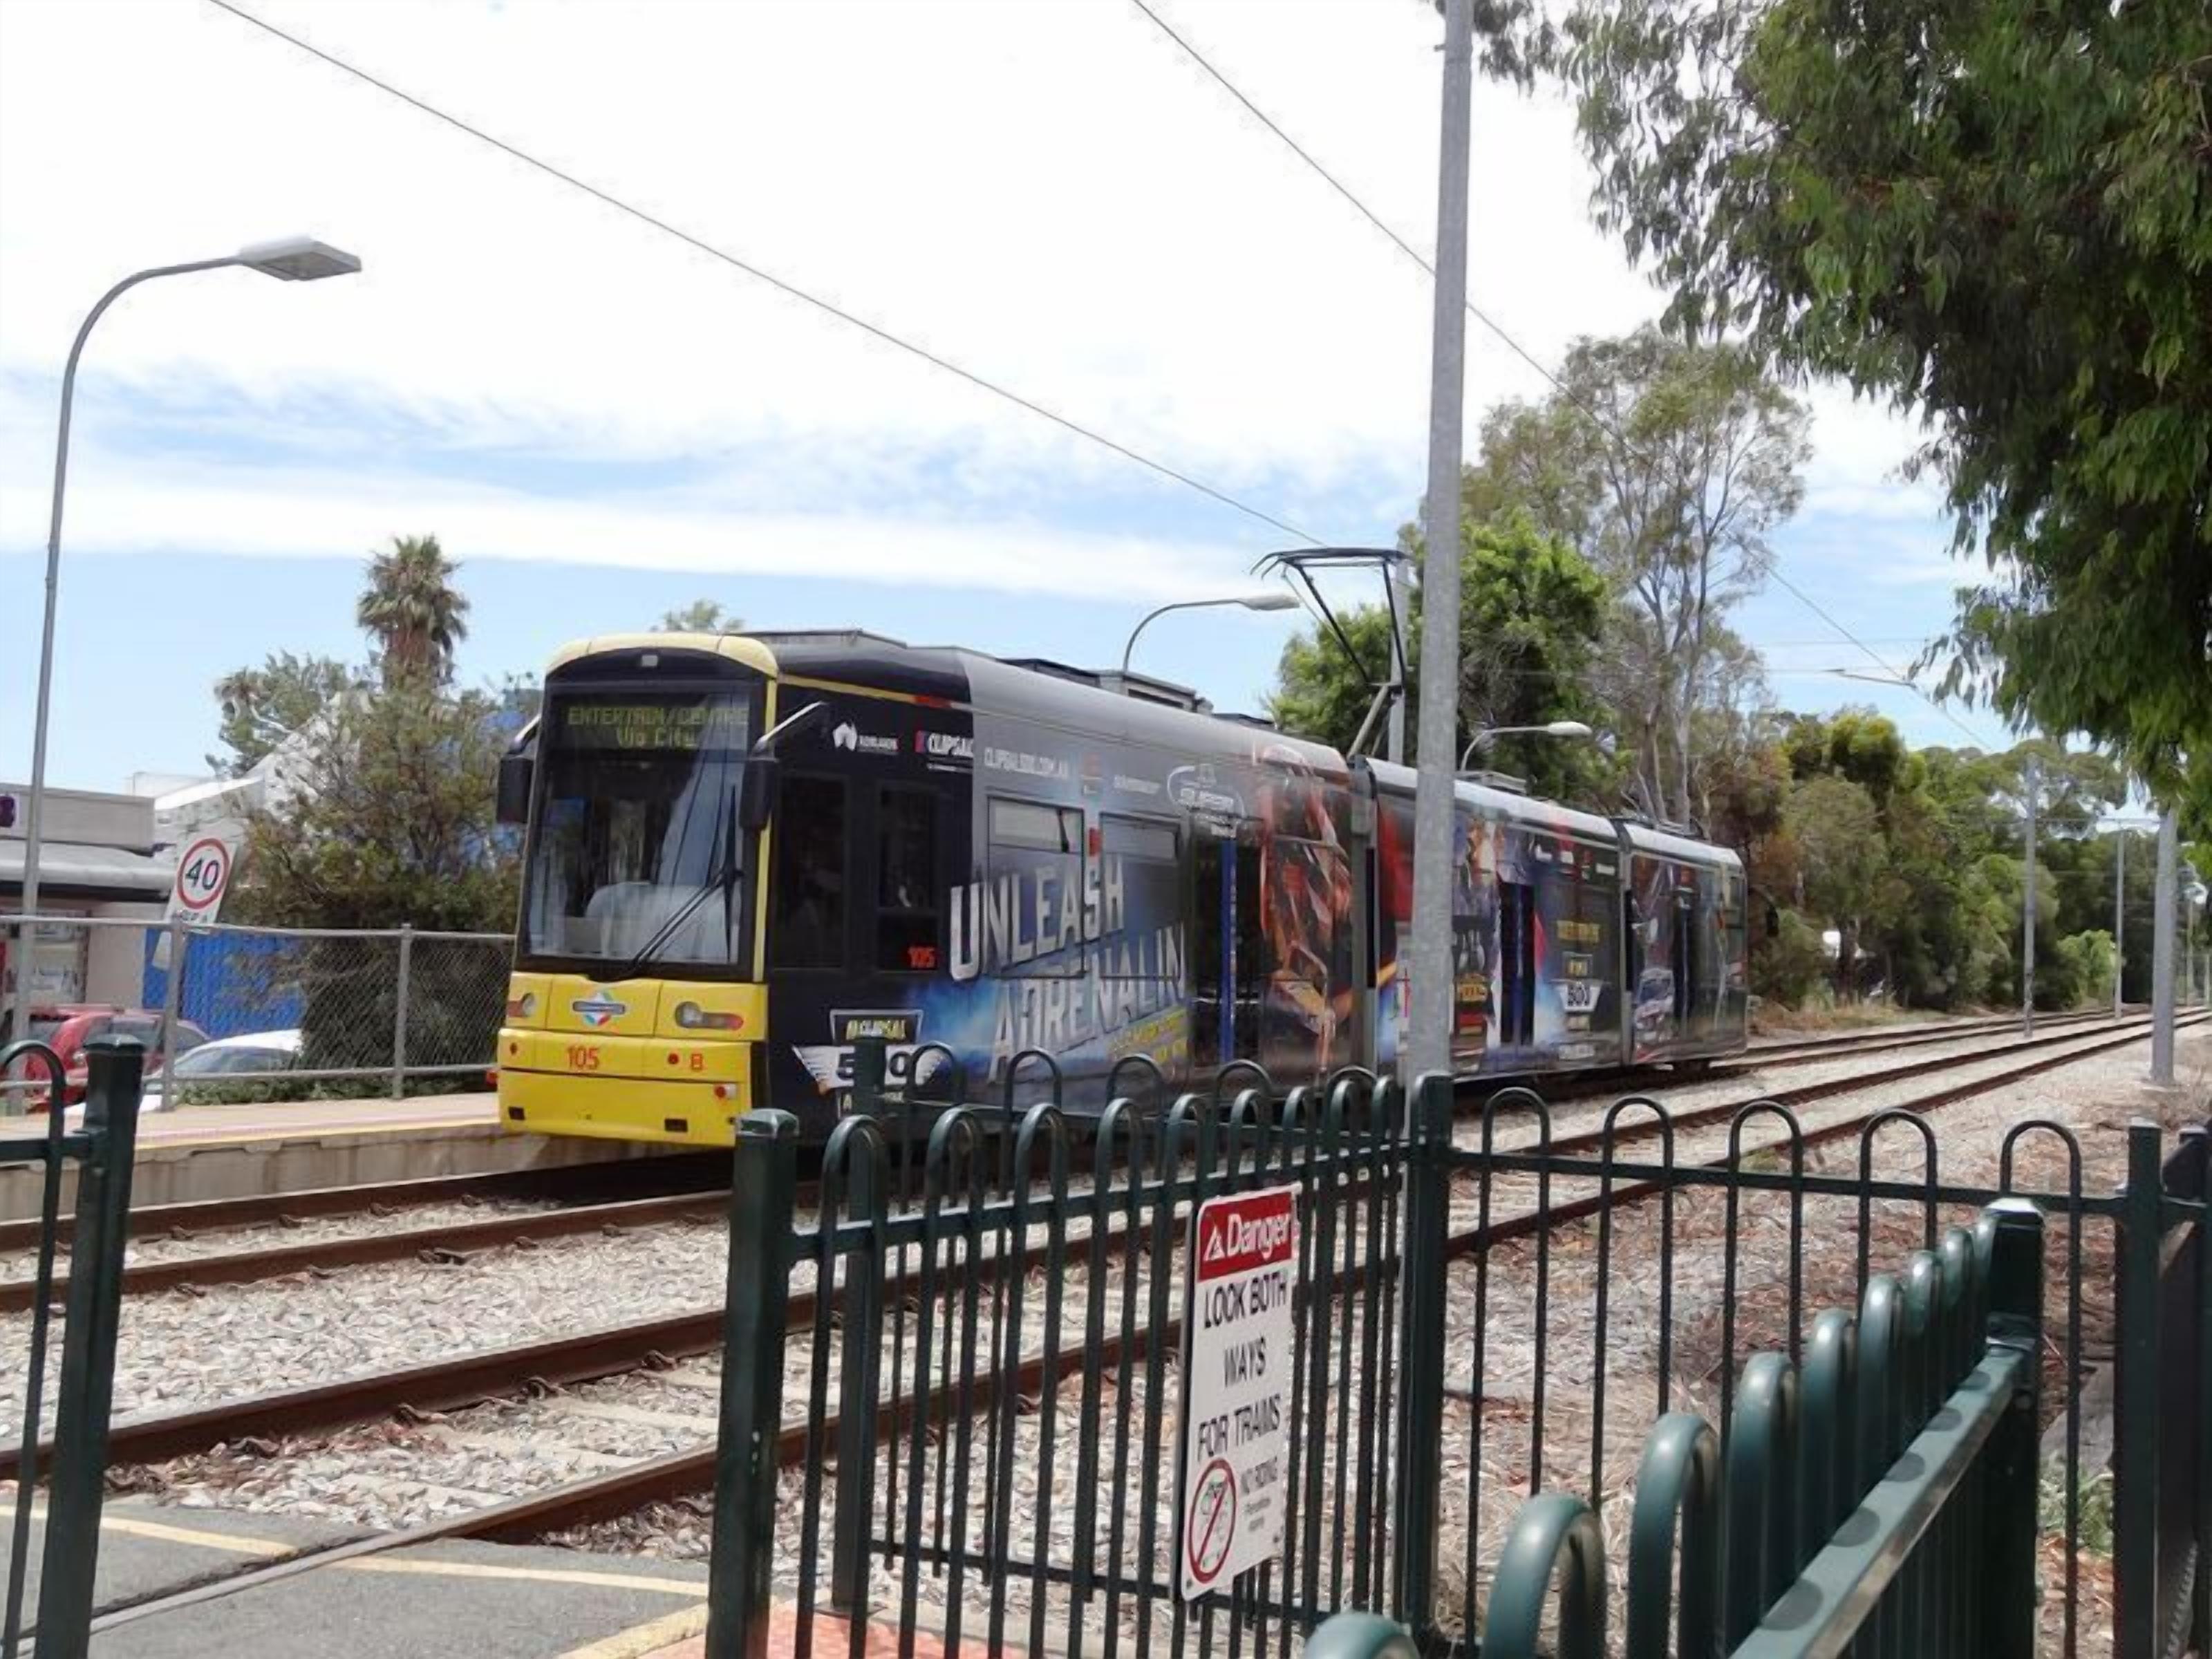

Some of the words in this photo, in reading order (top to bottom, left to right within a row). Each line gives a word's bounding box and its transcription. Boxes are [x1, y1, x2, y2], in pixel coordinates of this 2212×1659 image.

[185, 858, 219, 890] 40
[950, 852, 1125, 981] UNLEASH
[567, 1044, 600, 1070] 105
[836, 1051, 912, 1081] 50
[1227, 1212, 1291, 1261] Danger
[1204, 1282, 1246, 1329] LOOK
[1250, 1271, 1288, 1315] BOTH
[1224, 1333, 1266, 1387] WAYS
[1197, 1414, 1228, 1462] FOR
[1234, 1393, 1280, 1447] TRAMS
